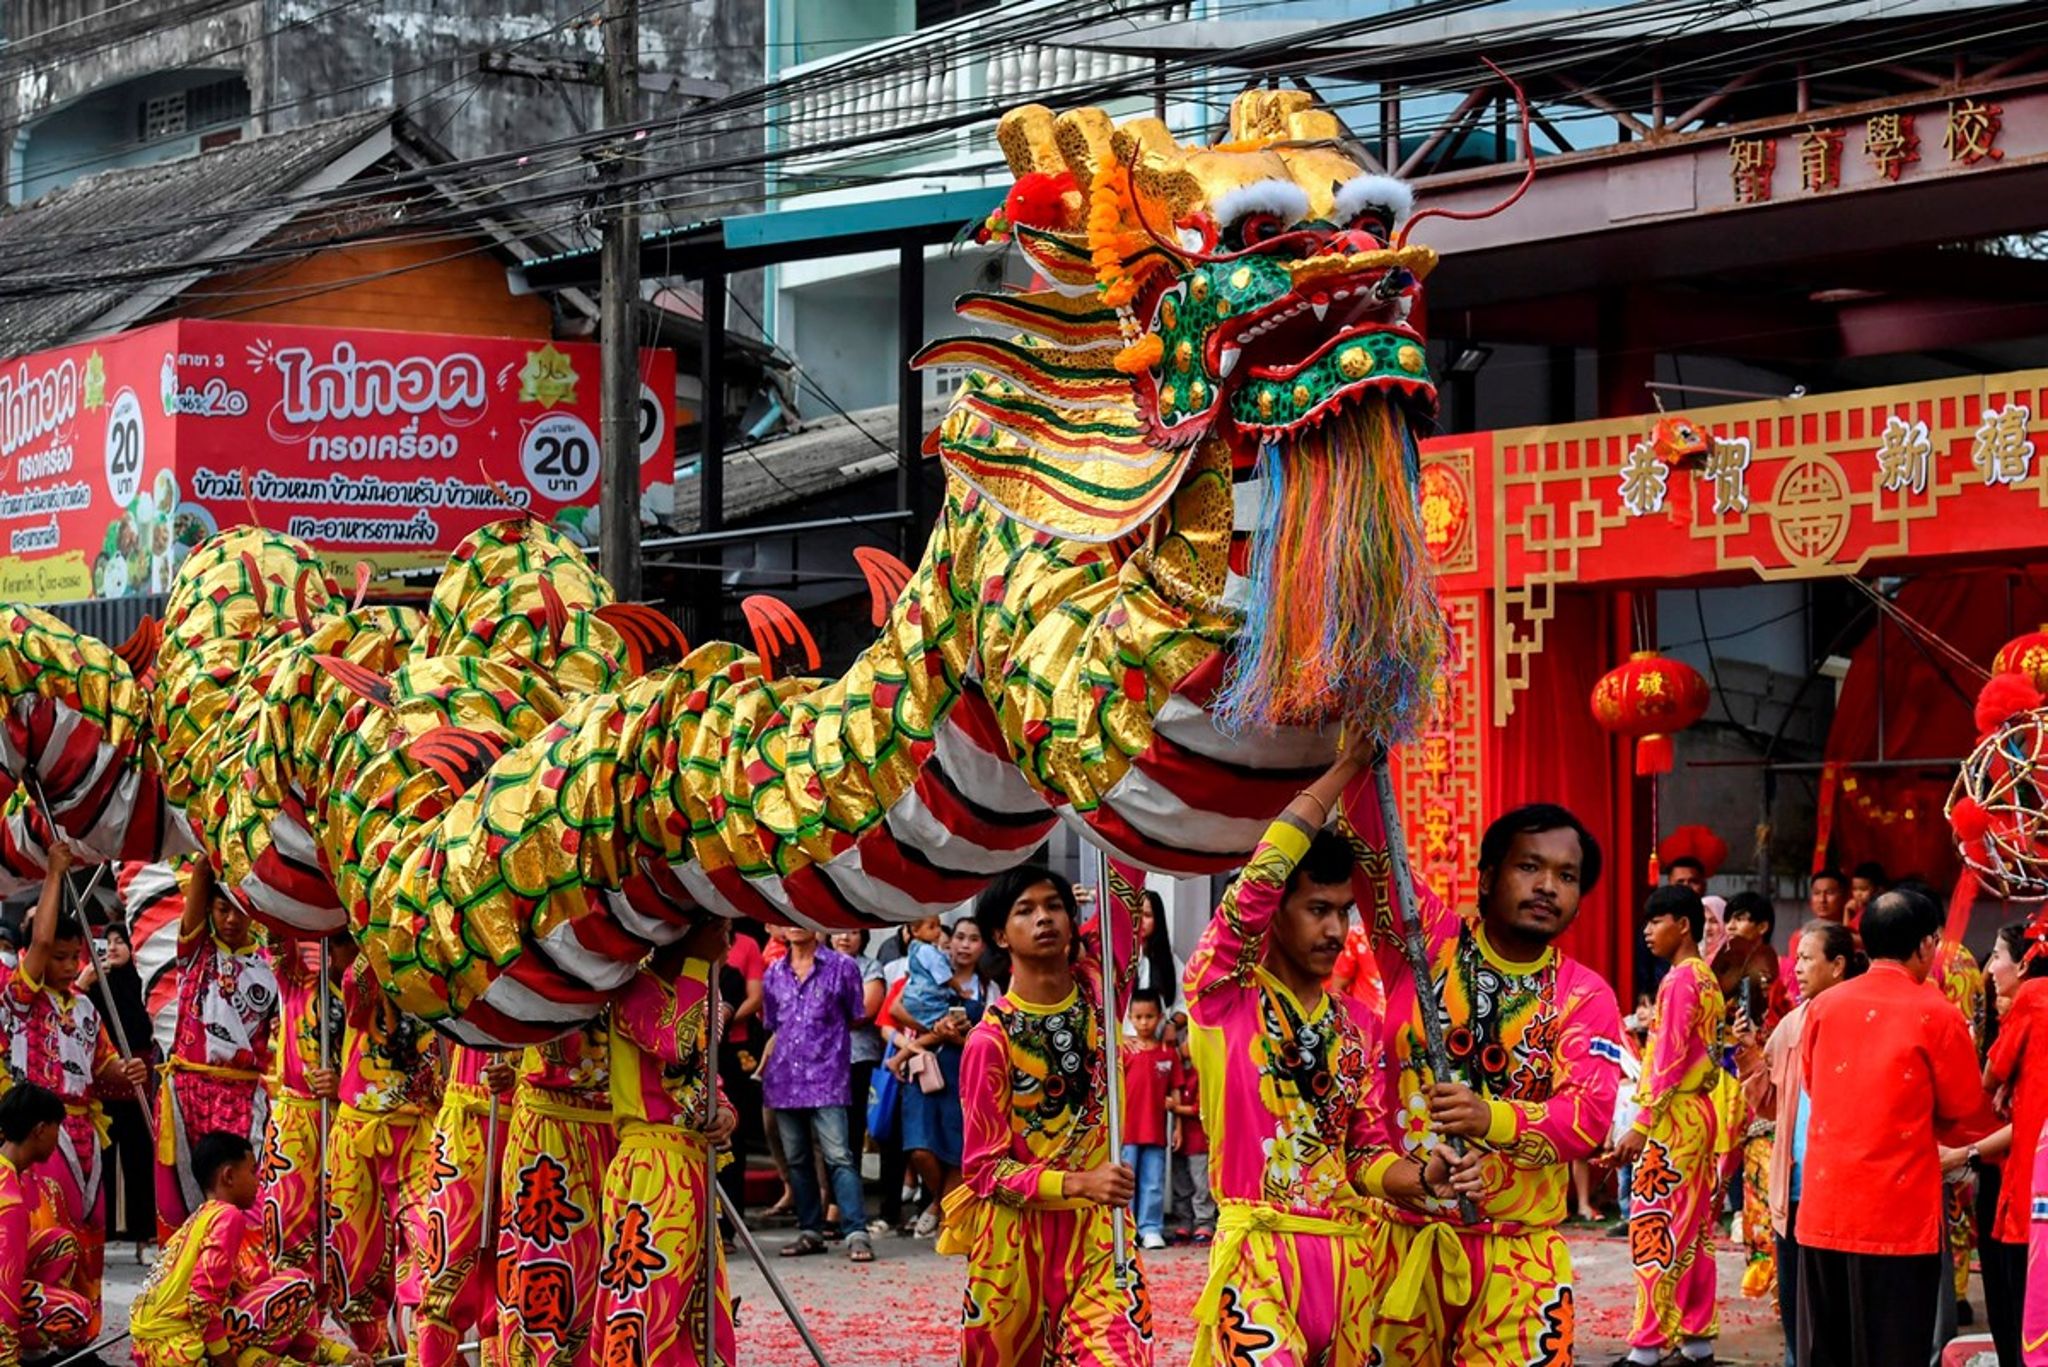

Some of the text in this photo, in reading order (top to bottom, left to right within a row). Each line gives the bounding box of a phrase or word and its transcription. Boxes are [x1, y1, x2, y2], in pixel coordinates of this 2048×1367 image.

[1728, 100, 2004, 203] 智育學校
[214, 353, 225, 367] 3
[275, 341, 485, 423] ไก่ทอด
[112, 419, 139, 474] 20
[308, 415, 458, 461] ทรงเครื่อง
[534, 436, 590, 477] 20
[257, 472, 327, 499] ข้าวหมก
[330, 475, 442, 504] ข้าวมันอาหรับ
[547, 479, 578, 492] บาท
[290, 511, 437, 541] และอาหารตามสั่ง
[513, 1153, 586, 1348] 泰國
